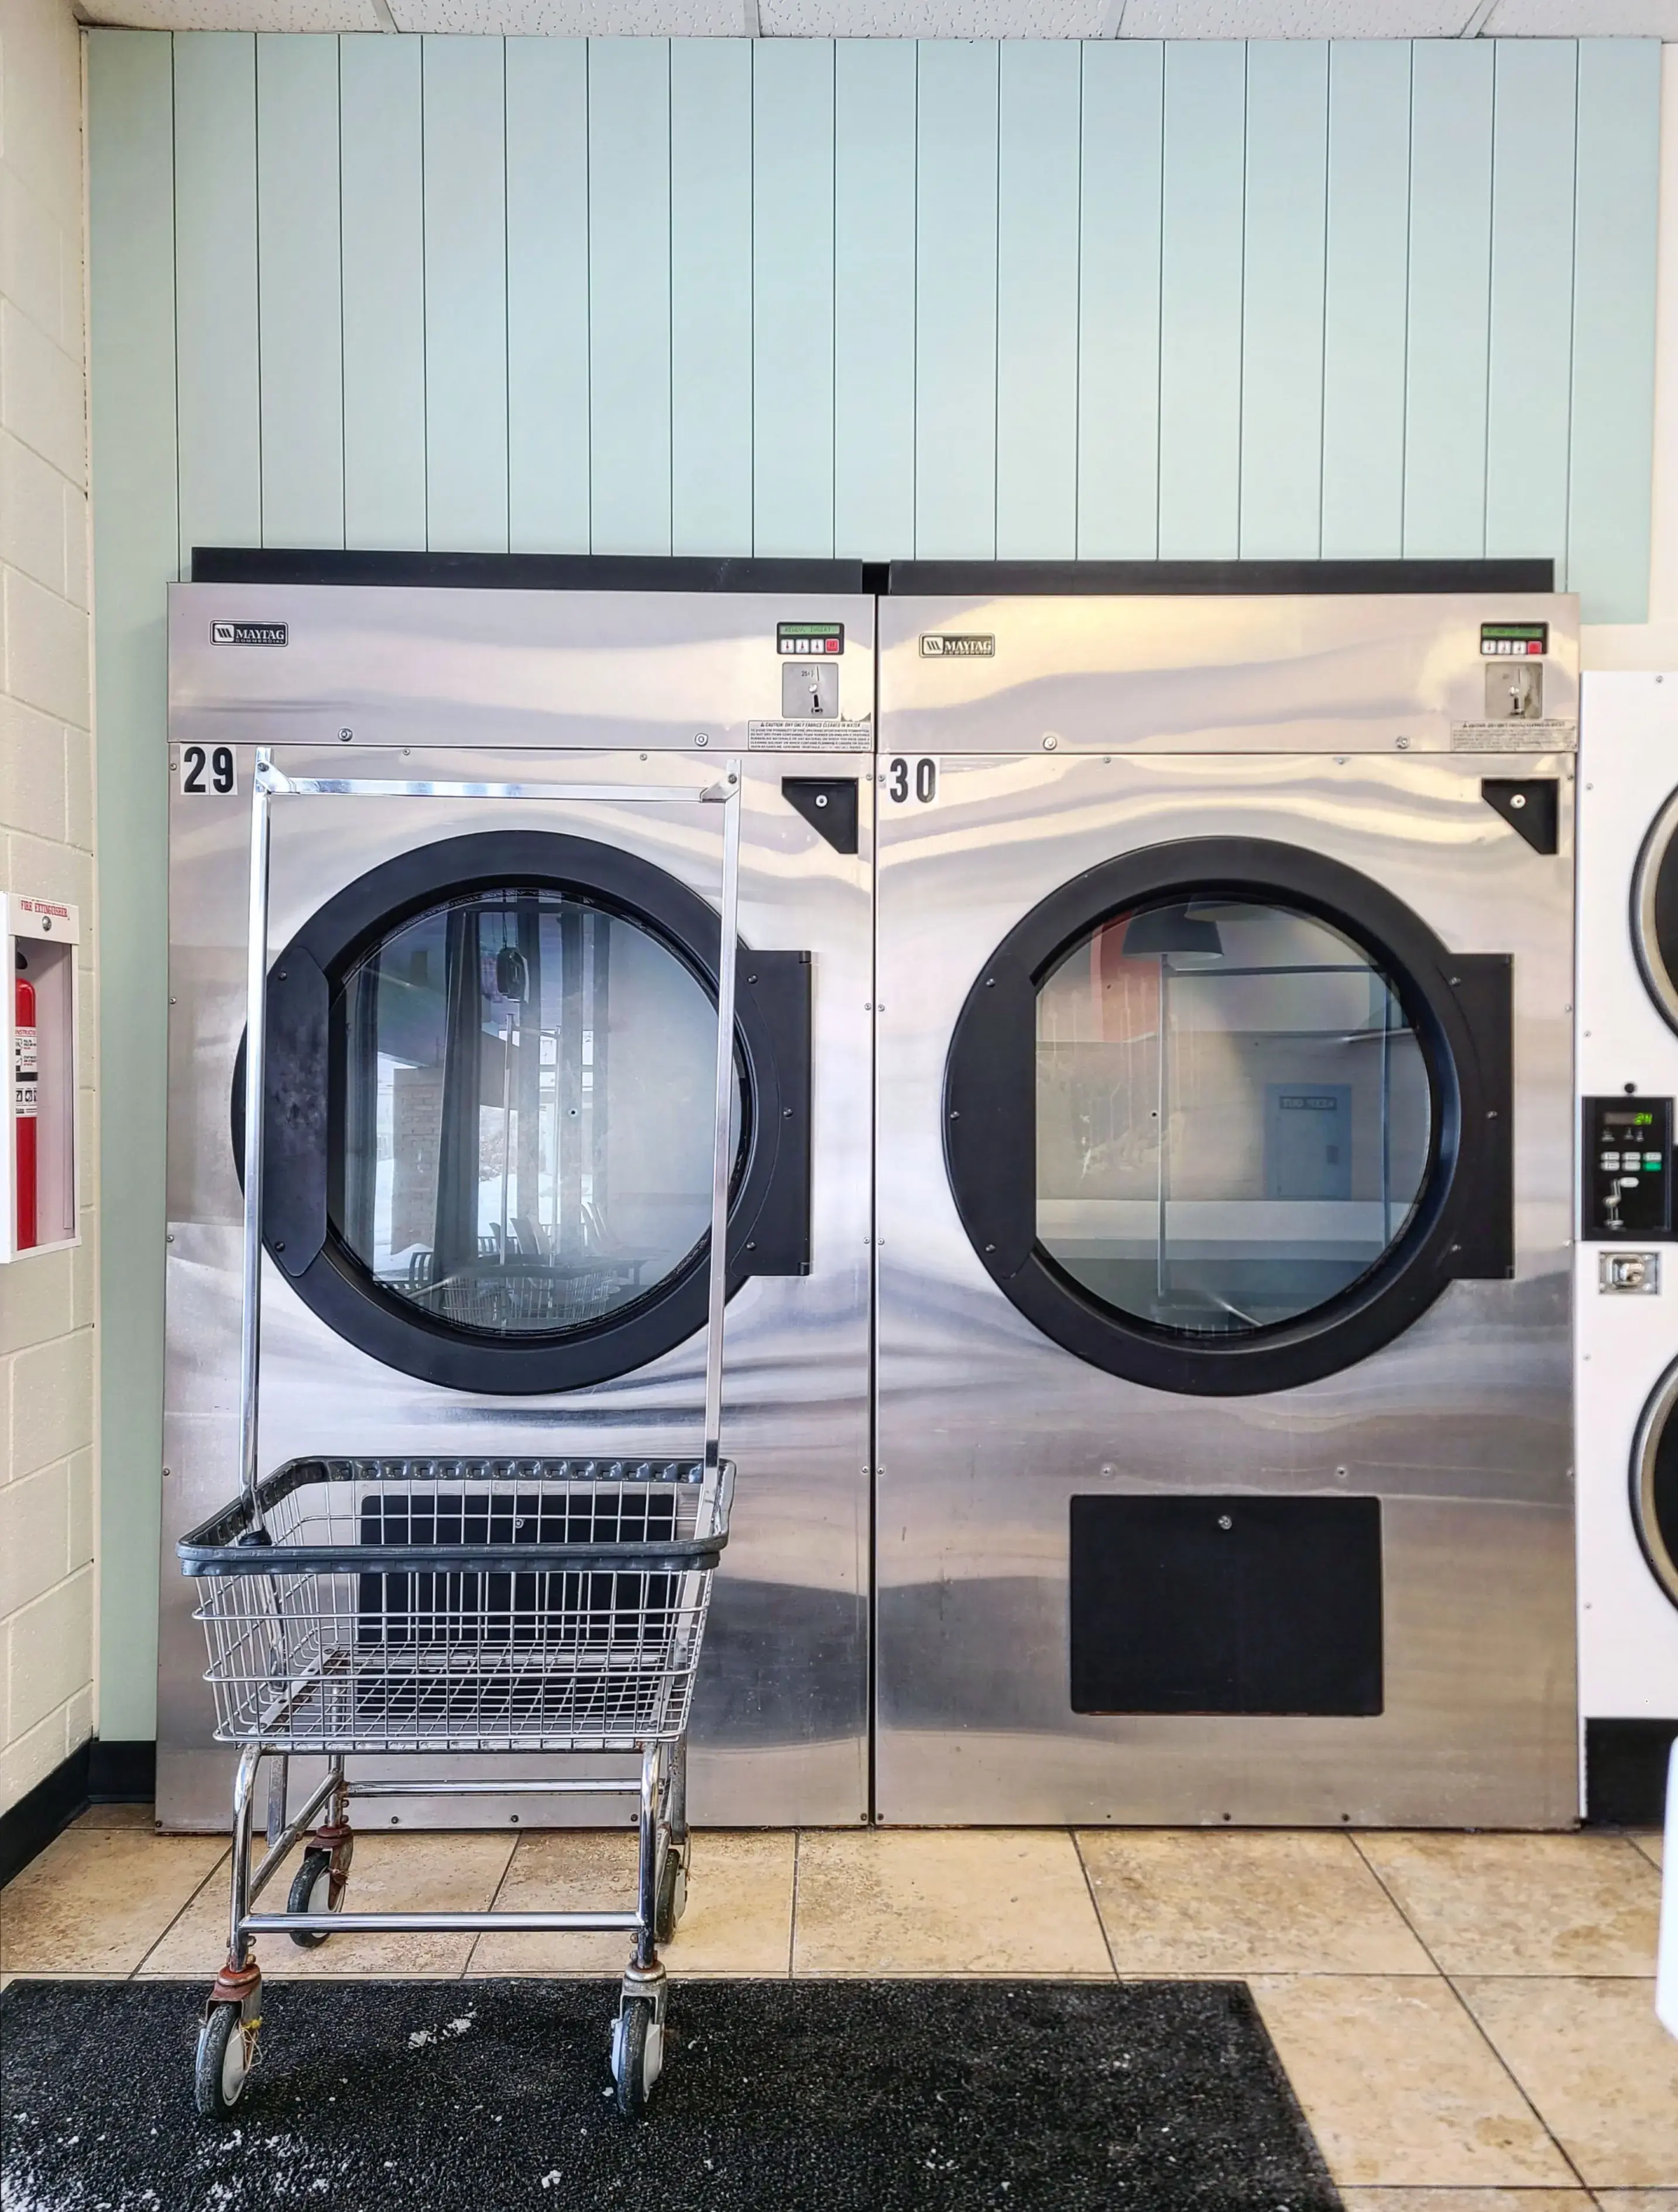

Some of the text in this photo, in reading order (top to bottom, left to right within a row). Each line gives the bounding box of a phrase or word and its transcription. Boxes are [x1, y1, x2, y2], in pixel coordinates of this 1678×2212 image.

[235, 629, 284, 640] MAYTAG
[944, 641, 991, 651] MAYTAG
[184, 746, 234, 793] 29
[890, 758, 936, 803] 30
[21, 900, 68, 918] FIRE EXTINGUISHER
